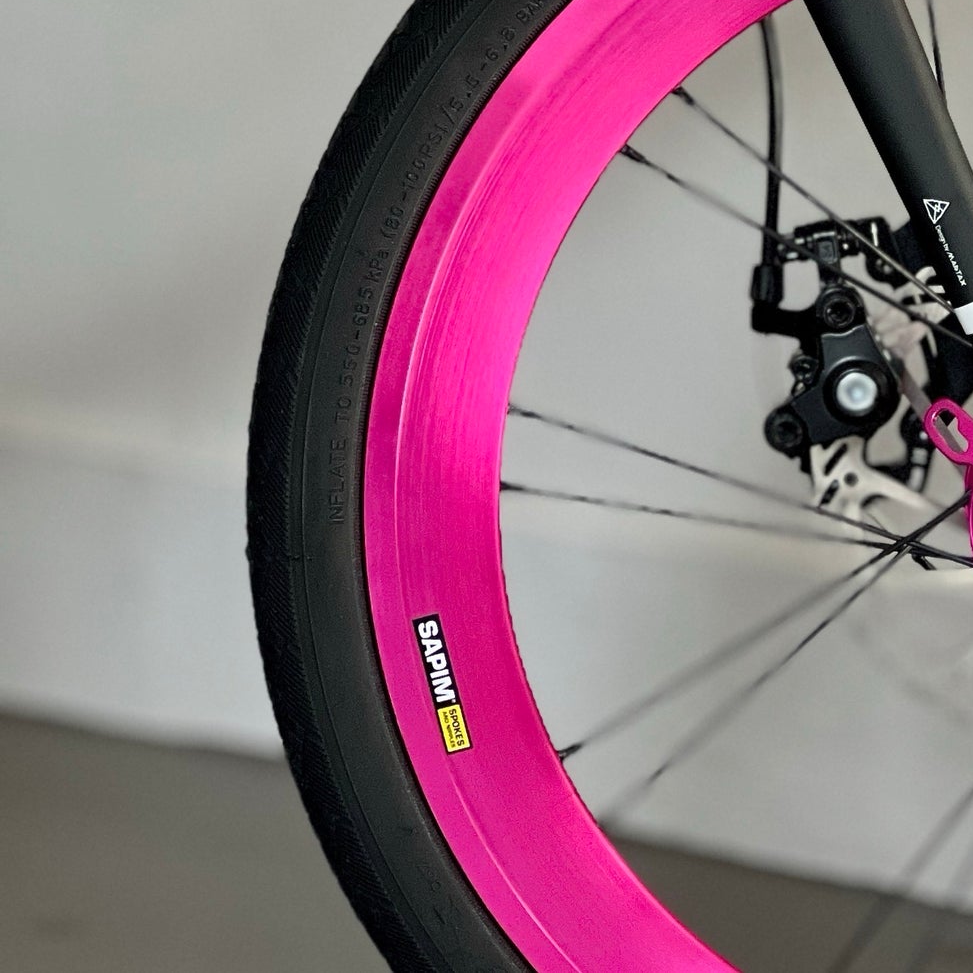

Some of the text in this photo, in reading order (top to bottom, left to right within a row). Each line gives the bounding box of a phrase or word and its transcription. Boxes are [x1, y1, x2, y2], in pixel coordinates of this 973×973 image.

[335, 396, 352, 426] TO
[327, 437, 348, 525] INFLATE
[418, 620, 456, 703] SAPIM
[449, 708, 464, 746] SPOKES
